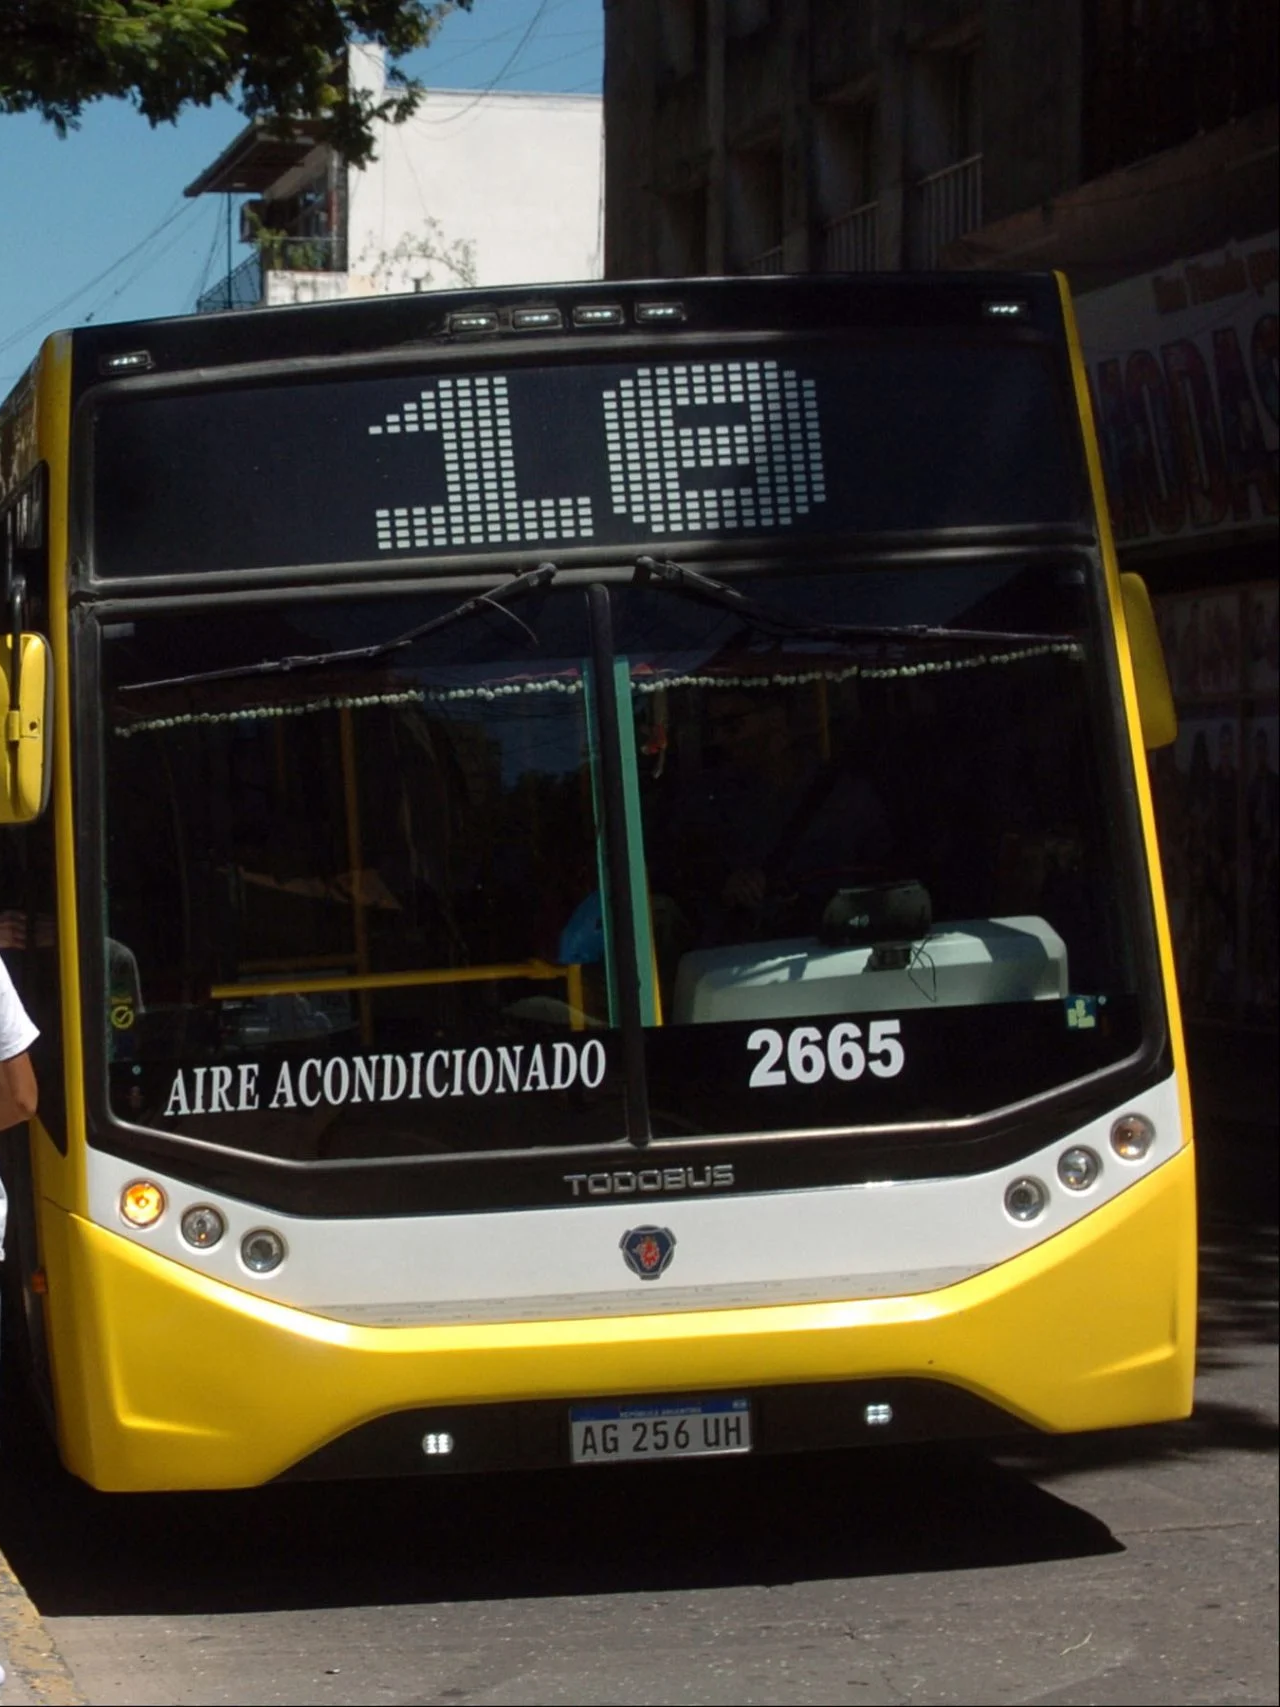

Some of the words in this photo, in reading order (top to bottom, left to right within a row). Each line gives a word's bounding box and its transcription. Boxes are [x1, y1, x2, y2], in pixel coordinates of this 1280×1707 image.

[368, 360, 826, 550] 18
[164, 1063, 259, 1116] AIRE
[269, 1038, 607, 1109] ACONDICIONADO
[747, 1019, 905, 1088] 2665
[563, 1164, 734, 1196] TODOBUS
[581, 1423, 620, 1456] AG
[631, 1419, 690, 1453] 256
[702, 1416, 742, 1448] UH
